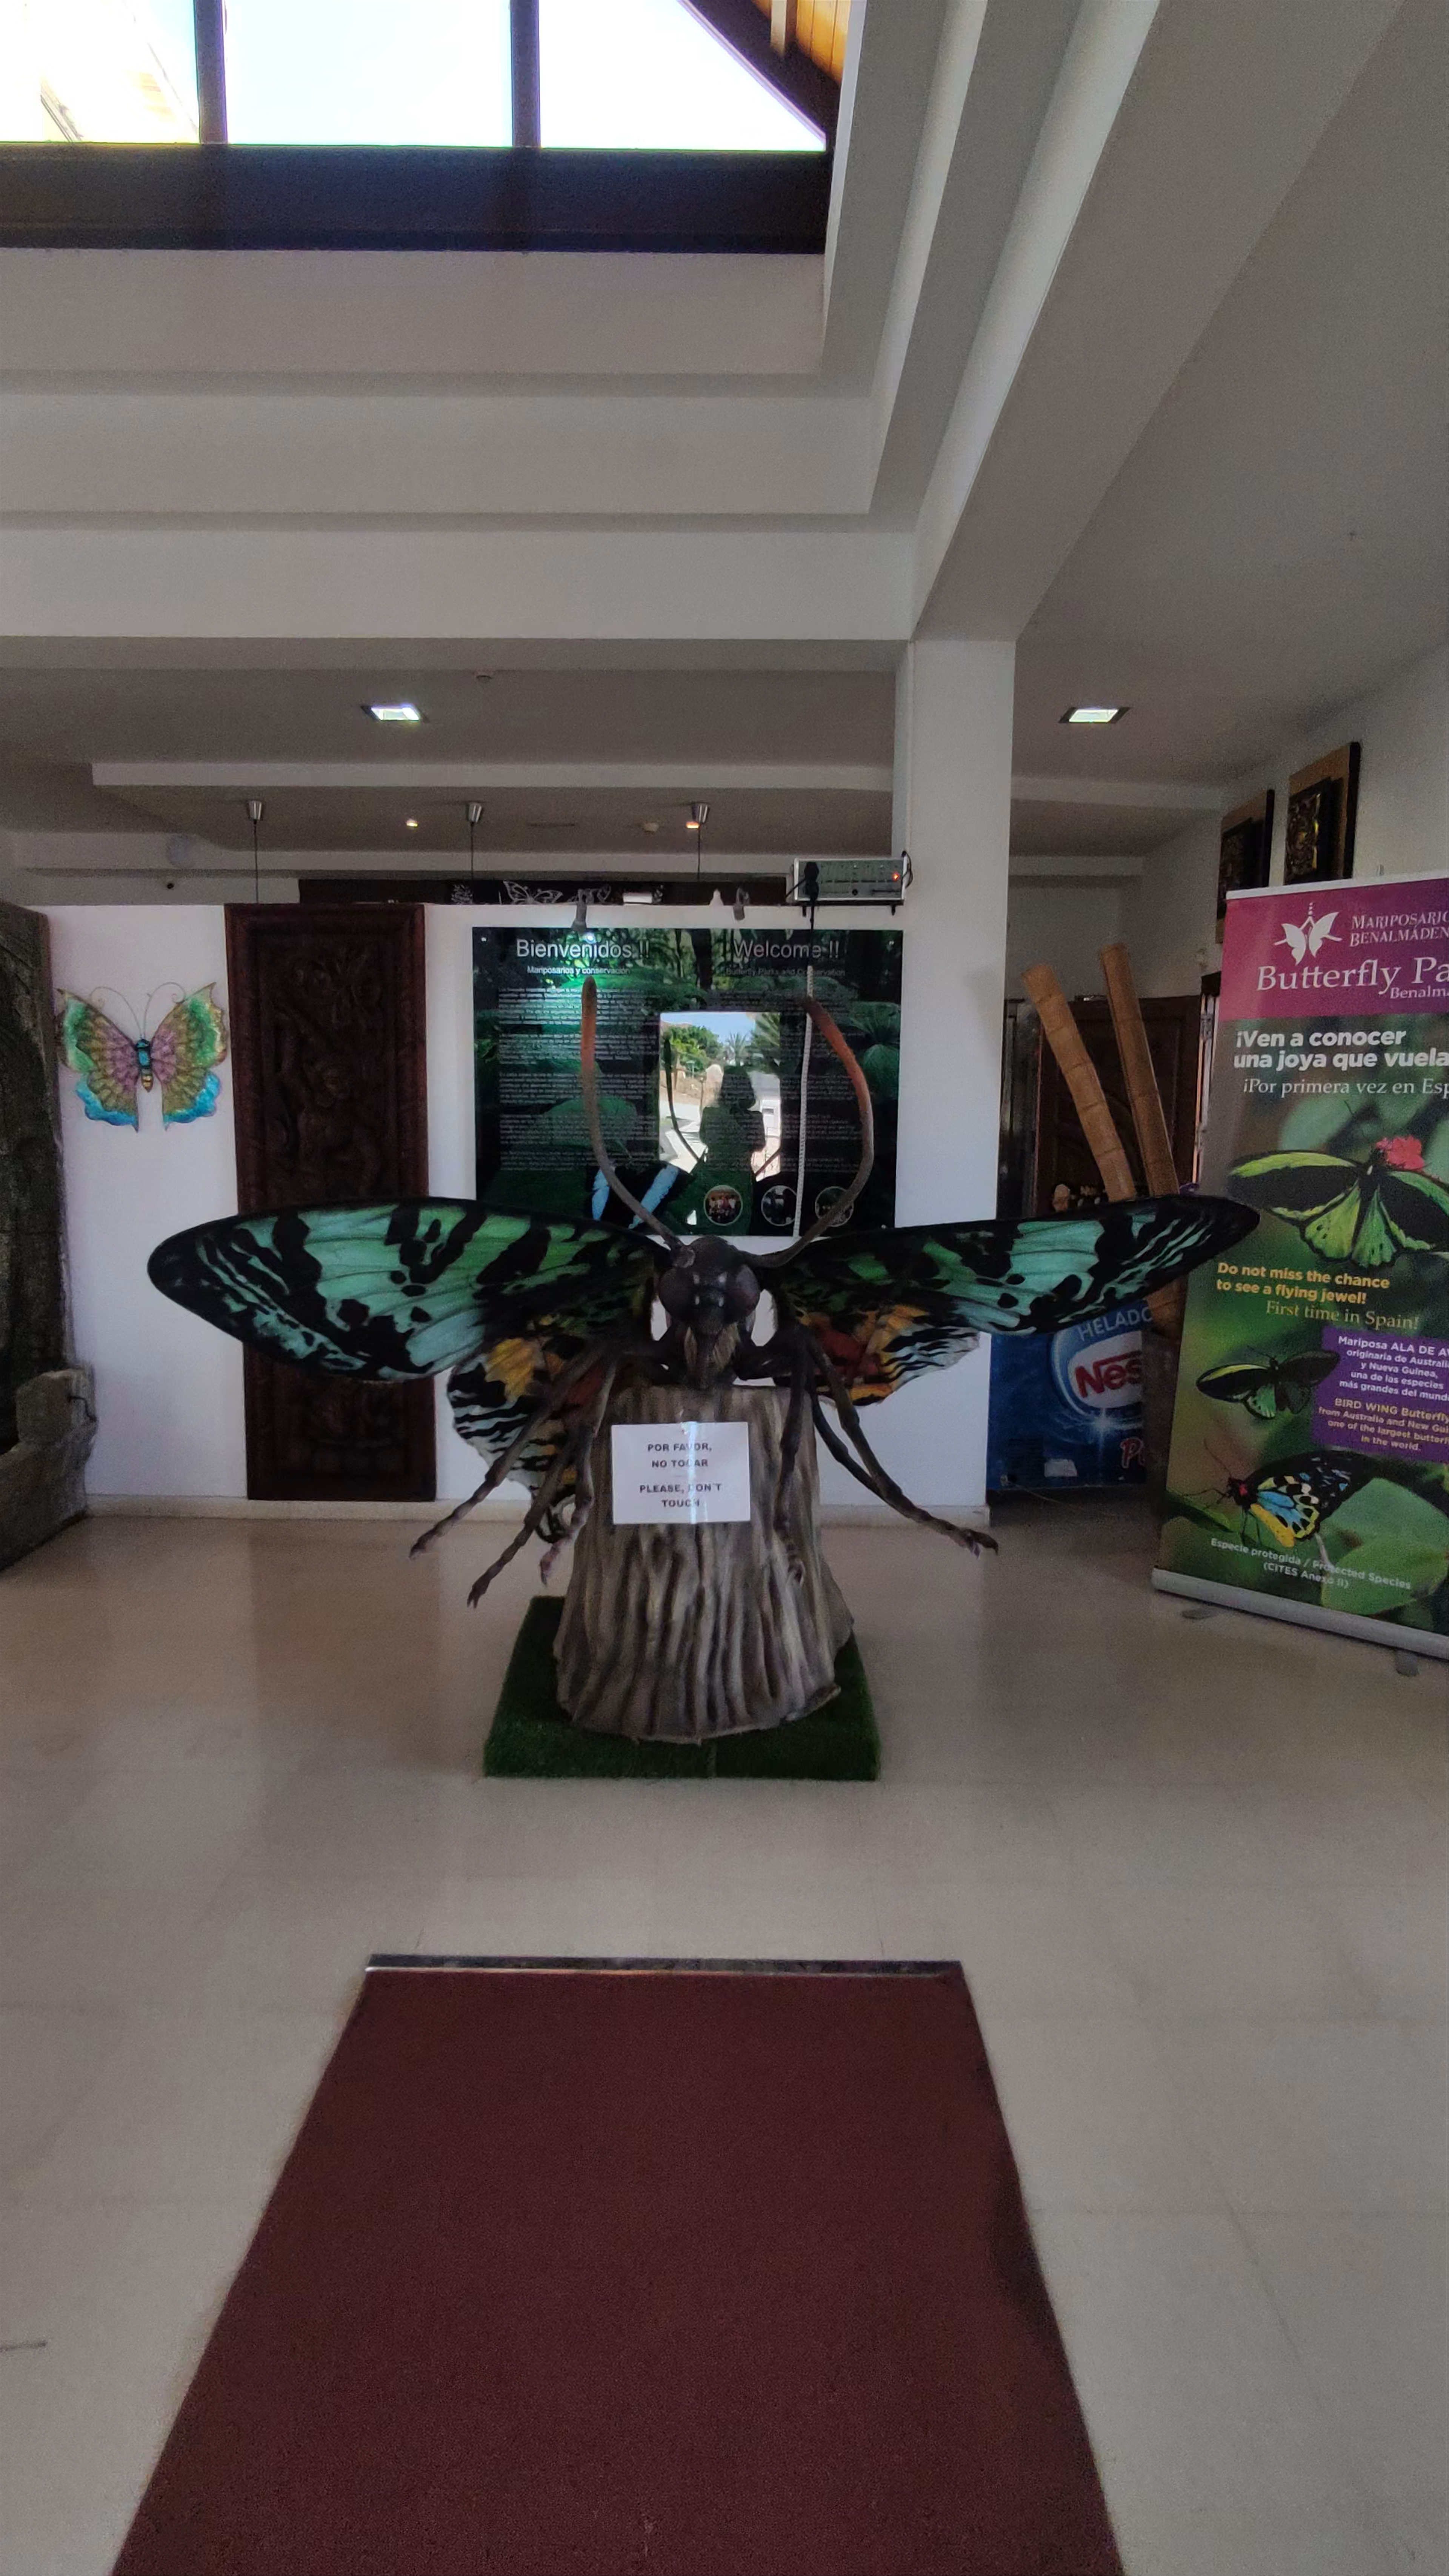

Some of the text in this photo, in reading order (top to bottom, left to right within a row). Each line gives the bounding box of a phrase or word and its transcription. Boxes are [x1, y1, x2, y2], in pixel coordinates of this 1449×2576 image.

[517, 939, 632, 958] Bienvenidos
[734, 940, 821, 958] Welcome
[528, 966, 574, 975] Mariposarios
[1257, 959, 1401, 995] Butterfly
[1390, 985, 1449, 999] Benalm
[1236, 1030, 1406, 1047] ¡Ven a conocer
[1234, 1053, 1272, 1068] una
[1277, 1050, 1327, 1071] joya
[1332, 1052, 1378, 1071] que
[1281, 1079, 1350, 1098] primera
[1357, 1082, 1386, 1094] vez
[1392, 1082, 1414, 1093] en
[1217, 1263, 1390, 1289] Do not miss the chance
[1217, 1279, 1367, 1304] to see a flying jewel!
[1266, 1300, 1419, 1330] First time in Spain!
[1338, 1336, 1387, 1350] Mariposa
[1391, 1343, 1415, 1353] ALA
[1419, 1346, 1435, 1355] DE
[1346, 1349, 1392, 1361] originaria
[1369, 1363, 1399, 1372] Nueva
[1402, 1367, 1438, 1379] Guinea,
[1340, 1380, 1358, 1389] más
[1361, 1383, 1399, 1395] grandes
[1385, 1375, 1398, 1383] las
[1401, 1378, 1444, 1390] especies
[1335, 1398, 1361, 1409] BIRD
[1366, 1403, 1397, 1415] WING
[1343, 1411, 1384, 1423] Australia
[1386, 1418, 1404, 1427] and
[1408, 1421, 1429, 1430] New
[1360, 1424, 1375, 1433] the
[1378, 1427, 1411, 1438] largest
[1373, 1437, 1387, 1446] the
[1391, 1441, 1421, 1451] world.
[640, 1485, 684, 1493] PLEASE,
[1211, 1538, 1249, 1554] Especie
[1251, 1548, 1301, 1566] protegida
[1303, 1558, 1309, 1567] /
[1368, 1572, 1411, 1589] Species
[1264, 1562, 1298, 1577] (CITES
